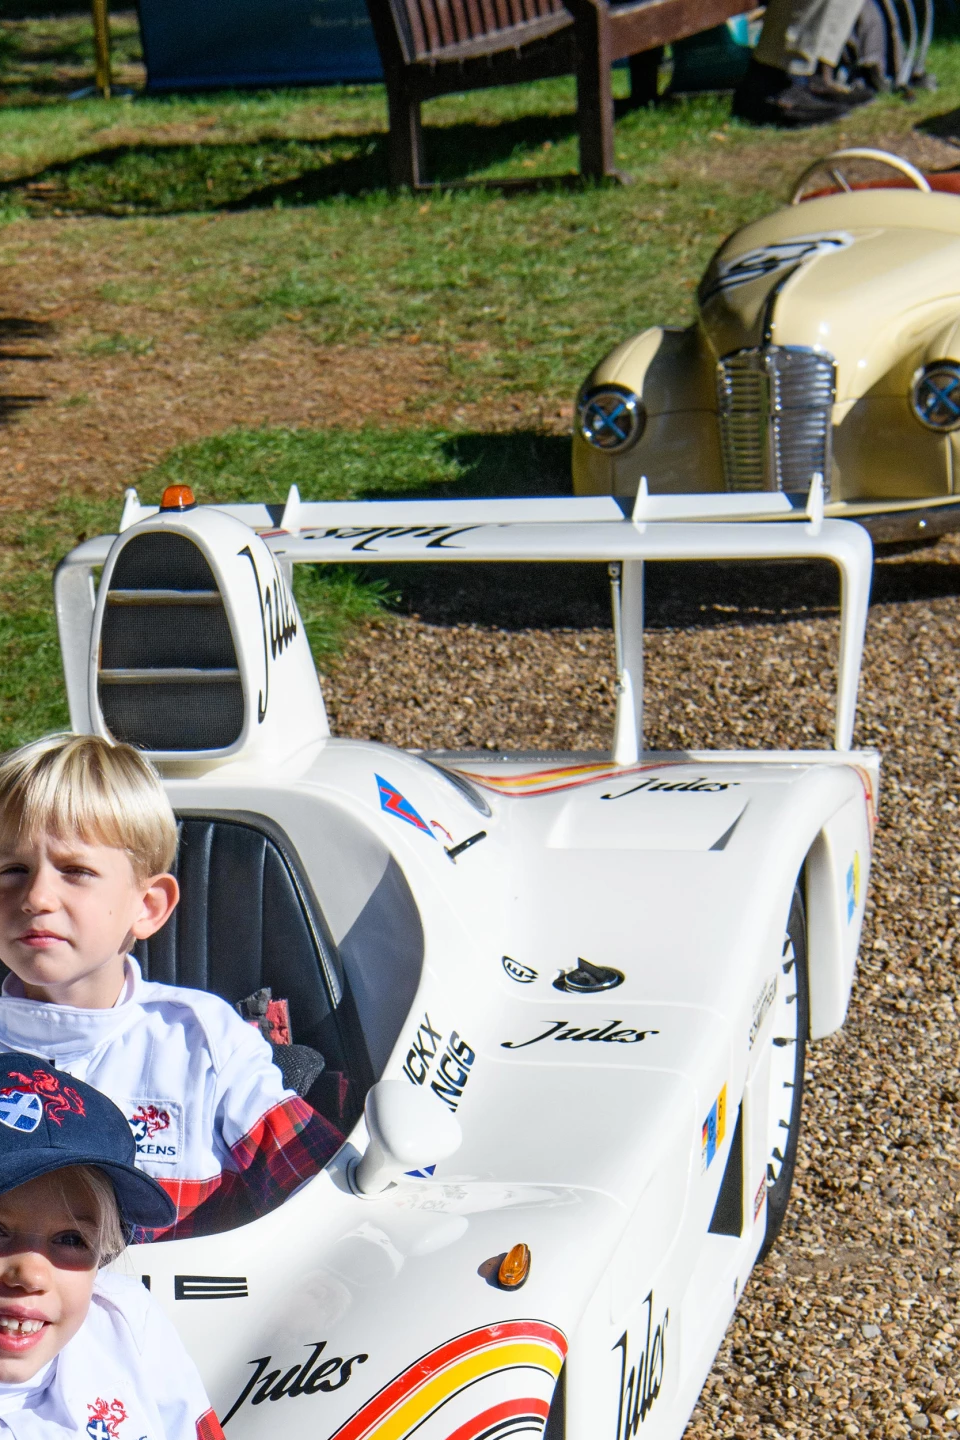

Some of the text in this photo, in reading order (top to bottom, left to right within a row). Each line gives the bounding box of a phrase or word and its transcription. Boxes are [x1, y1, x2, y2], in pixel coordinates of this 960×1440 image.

[600, 776, 741, 800] Jules
[402, 1011, 443, 1087] ICKX
[500, 1019, 660, 1049] Jules
[429, 1029, 477, 1113] NCIS
[135, 1143, 177, 1156] KENS
[219, 1340, 369, 1429] Jules
